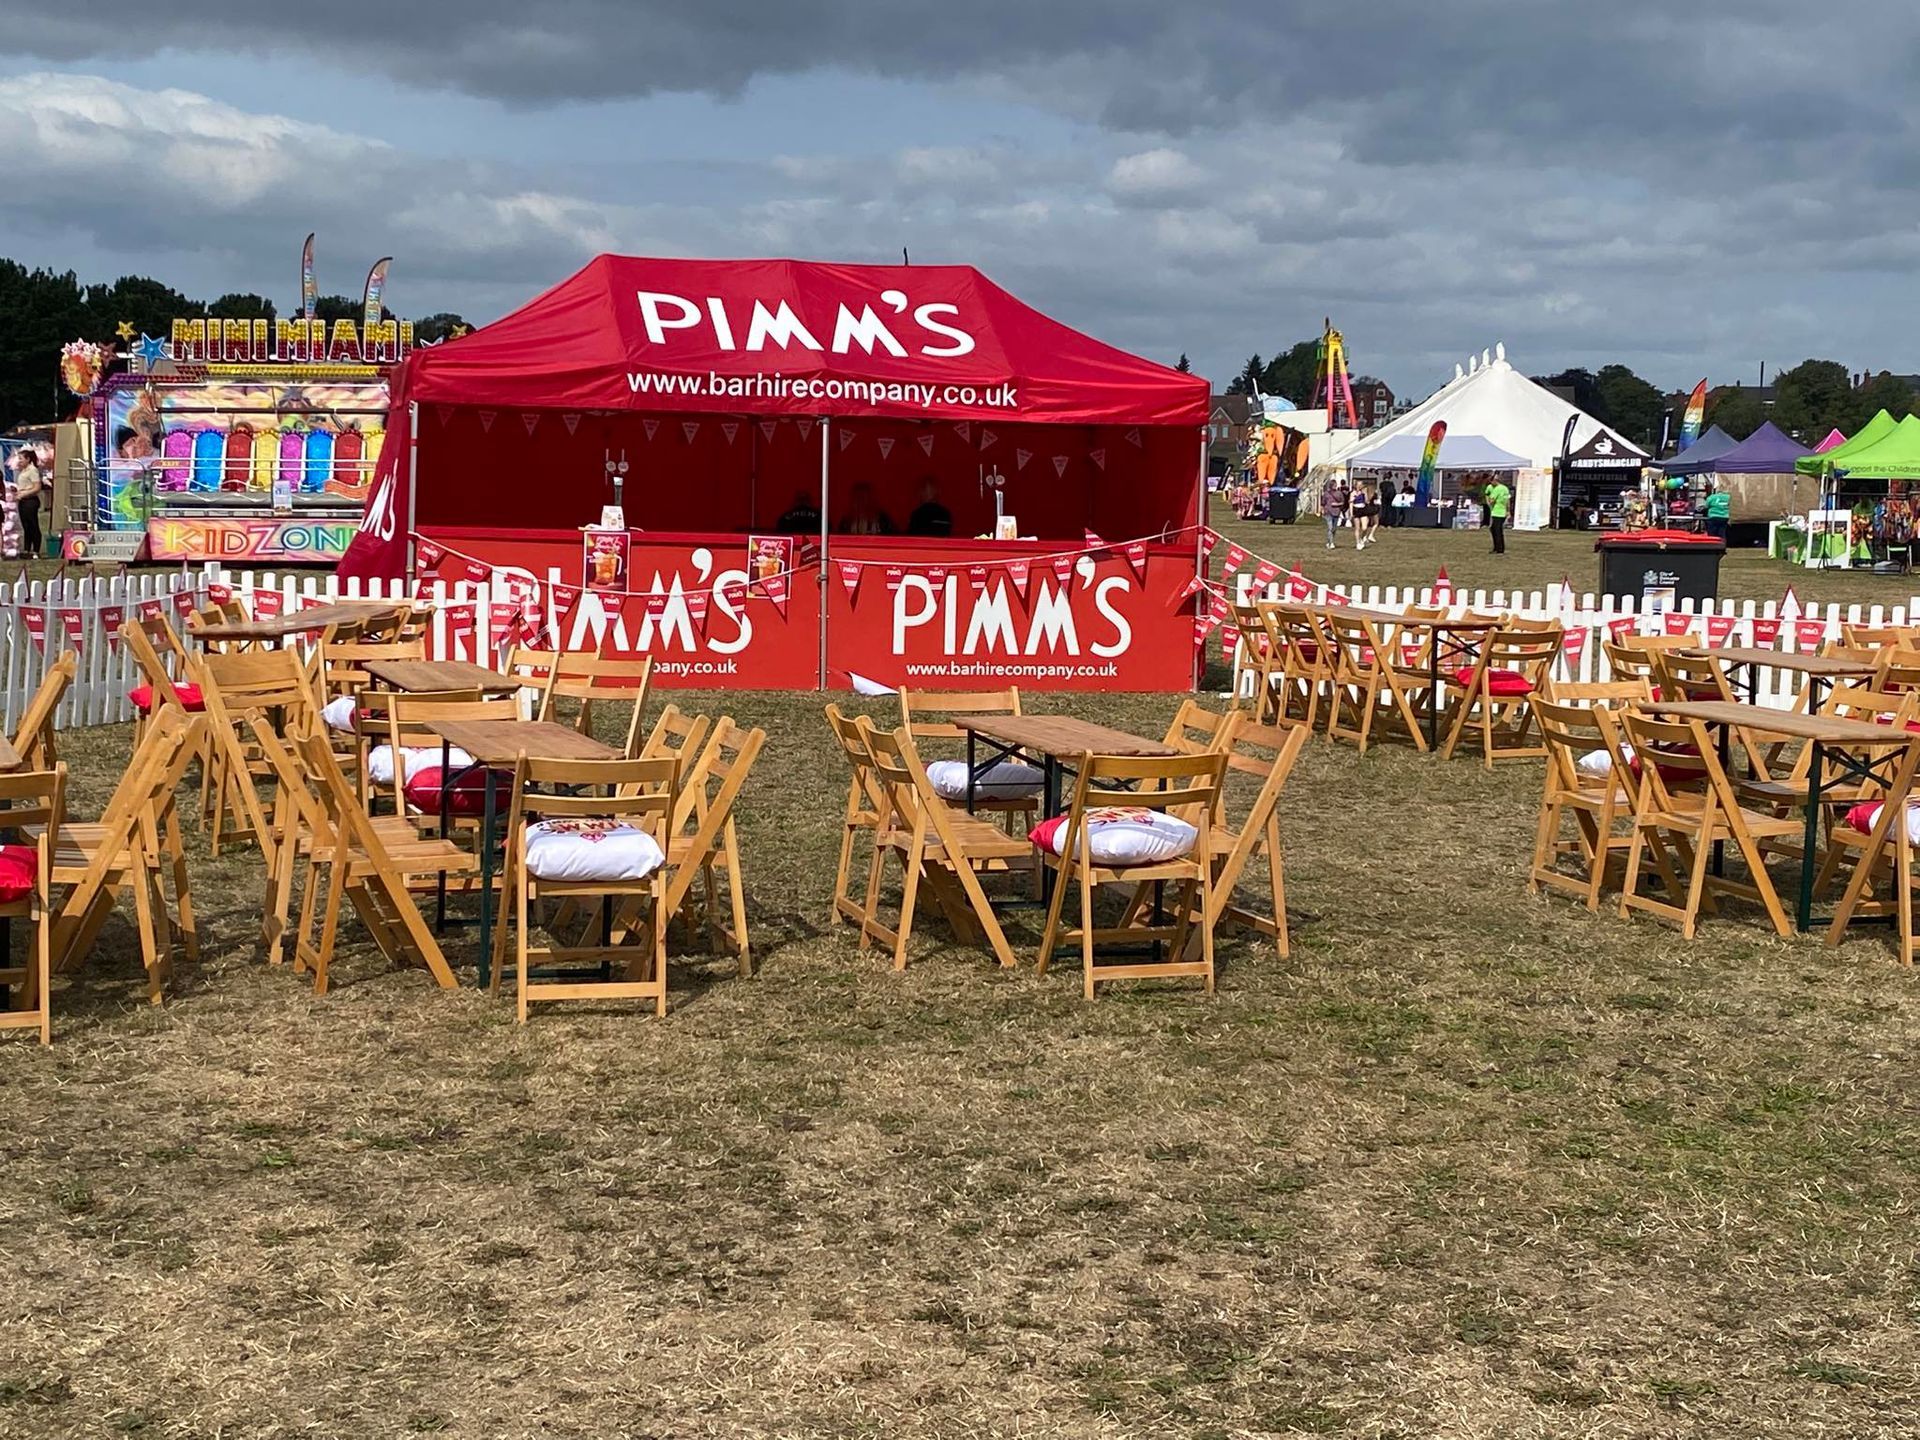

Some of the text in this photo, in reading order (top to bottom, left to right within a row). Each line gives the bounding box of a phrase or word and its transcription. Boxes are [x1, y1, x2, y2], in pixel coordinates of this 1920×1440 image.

[172, 319, 414, 363] MINI MIAMI
[637, 290, 976, 358] PIMM'S
[627, 371, 1018, 408] www.barhirecompany.co.uk
[892, 556, 1133, 658] PIMM'S
[906, 661, 1118, 680] www.barhirecompany.co.uk
